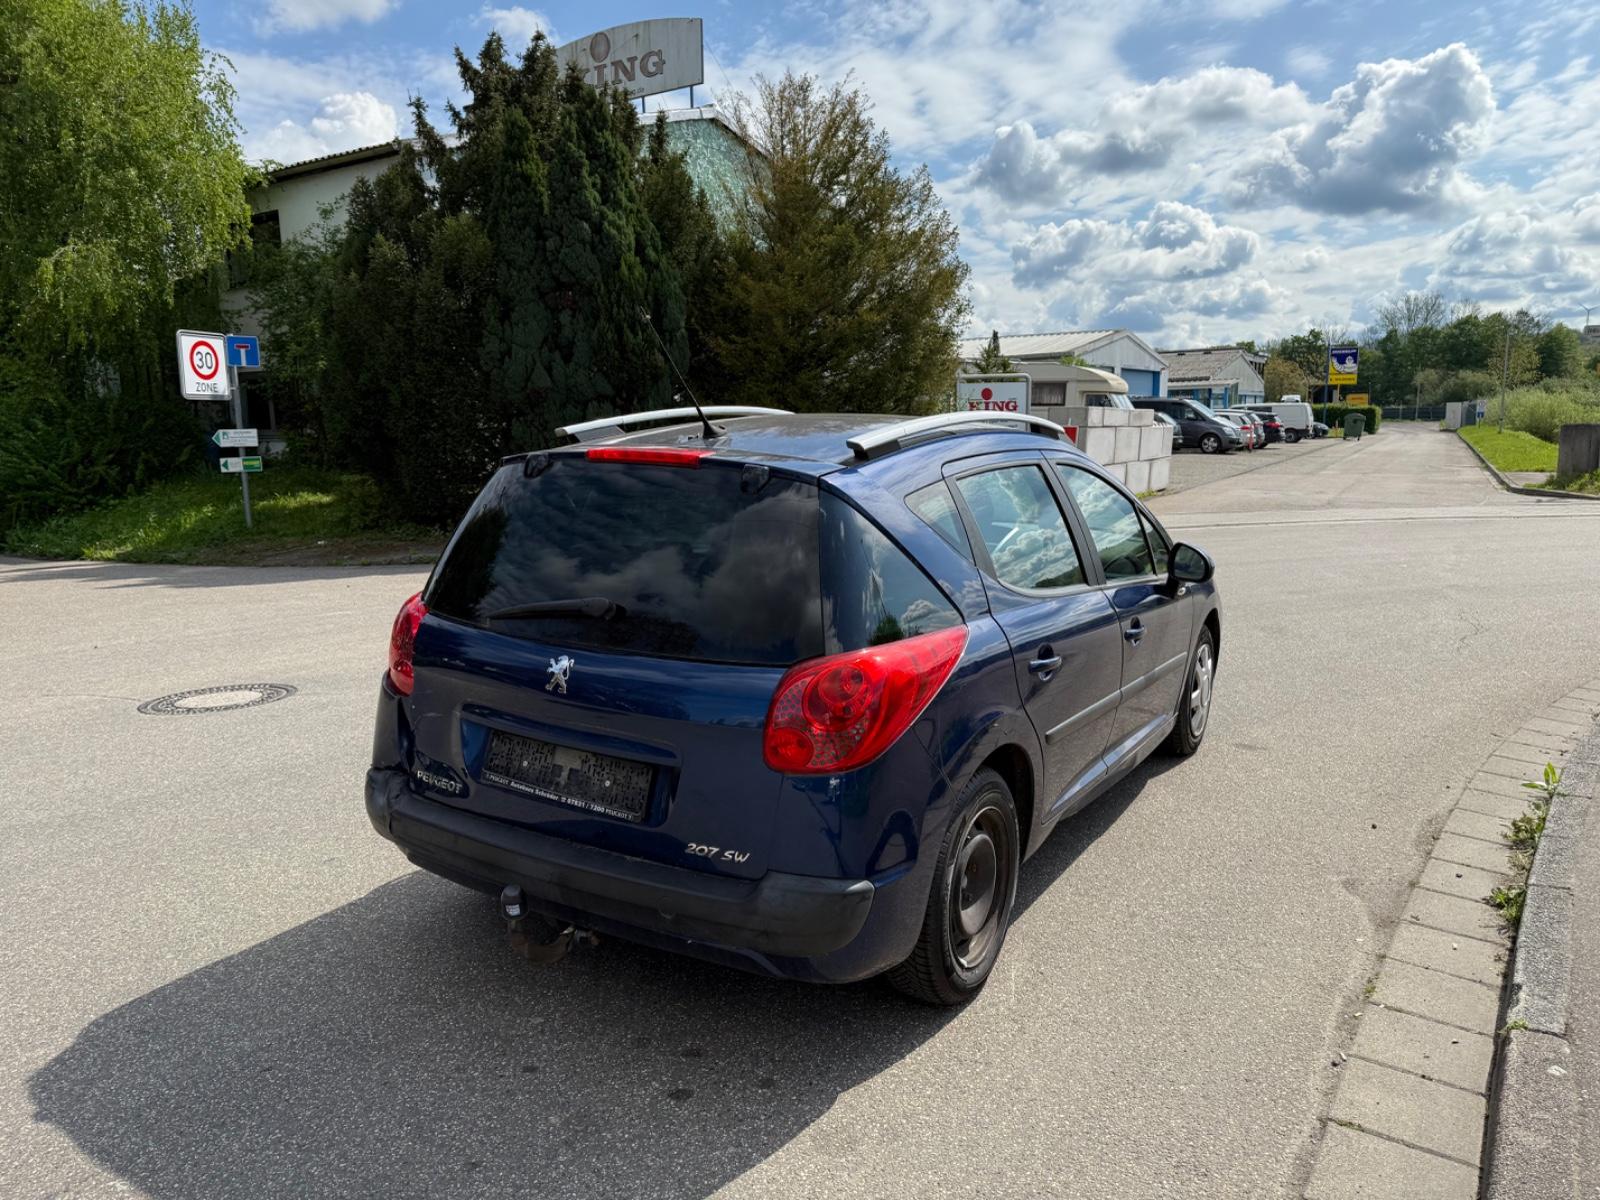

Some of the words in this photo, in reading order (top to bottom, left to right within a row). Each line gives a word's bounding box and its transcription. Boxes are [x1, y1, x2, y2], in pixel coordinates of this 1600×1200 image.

[582, 48, 666, 90] ING
[195, 351, 214, 370] 30
[195, 381, 219, 393] ZONE
[416, 770, 463, 794] PEUGEOT
[685, 843, 720, 858] 207
[720, 850, 751, 863] SW
